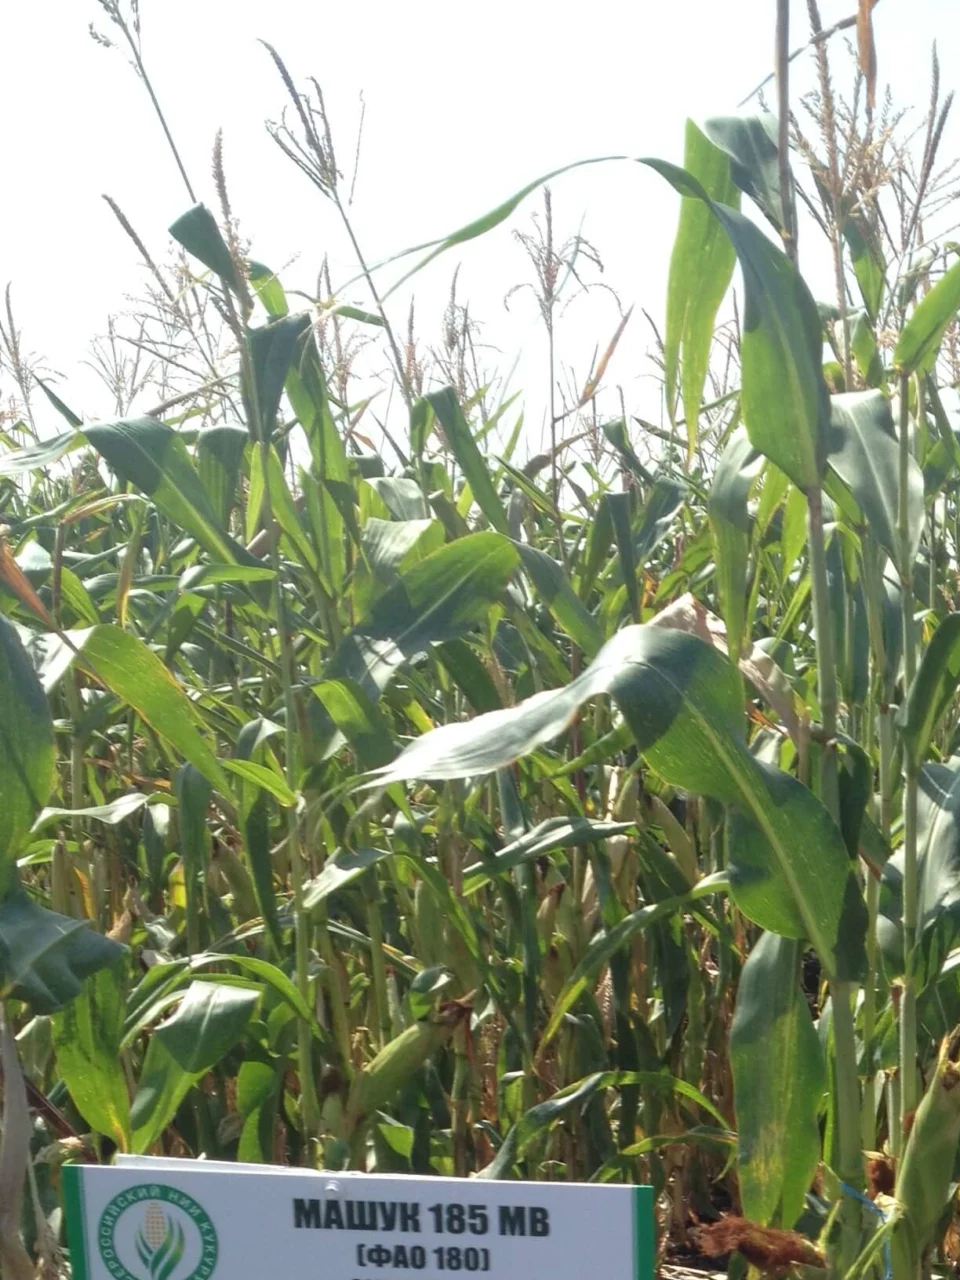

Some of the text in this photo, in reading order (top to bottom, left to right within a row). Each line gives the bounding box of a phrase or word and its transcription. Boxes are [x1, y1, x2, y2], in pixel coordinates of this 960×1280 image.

[168, 1190, 201, 1217] НИИ
[293, 1198, 550, 1237] МАШУК 185 МВ
